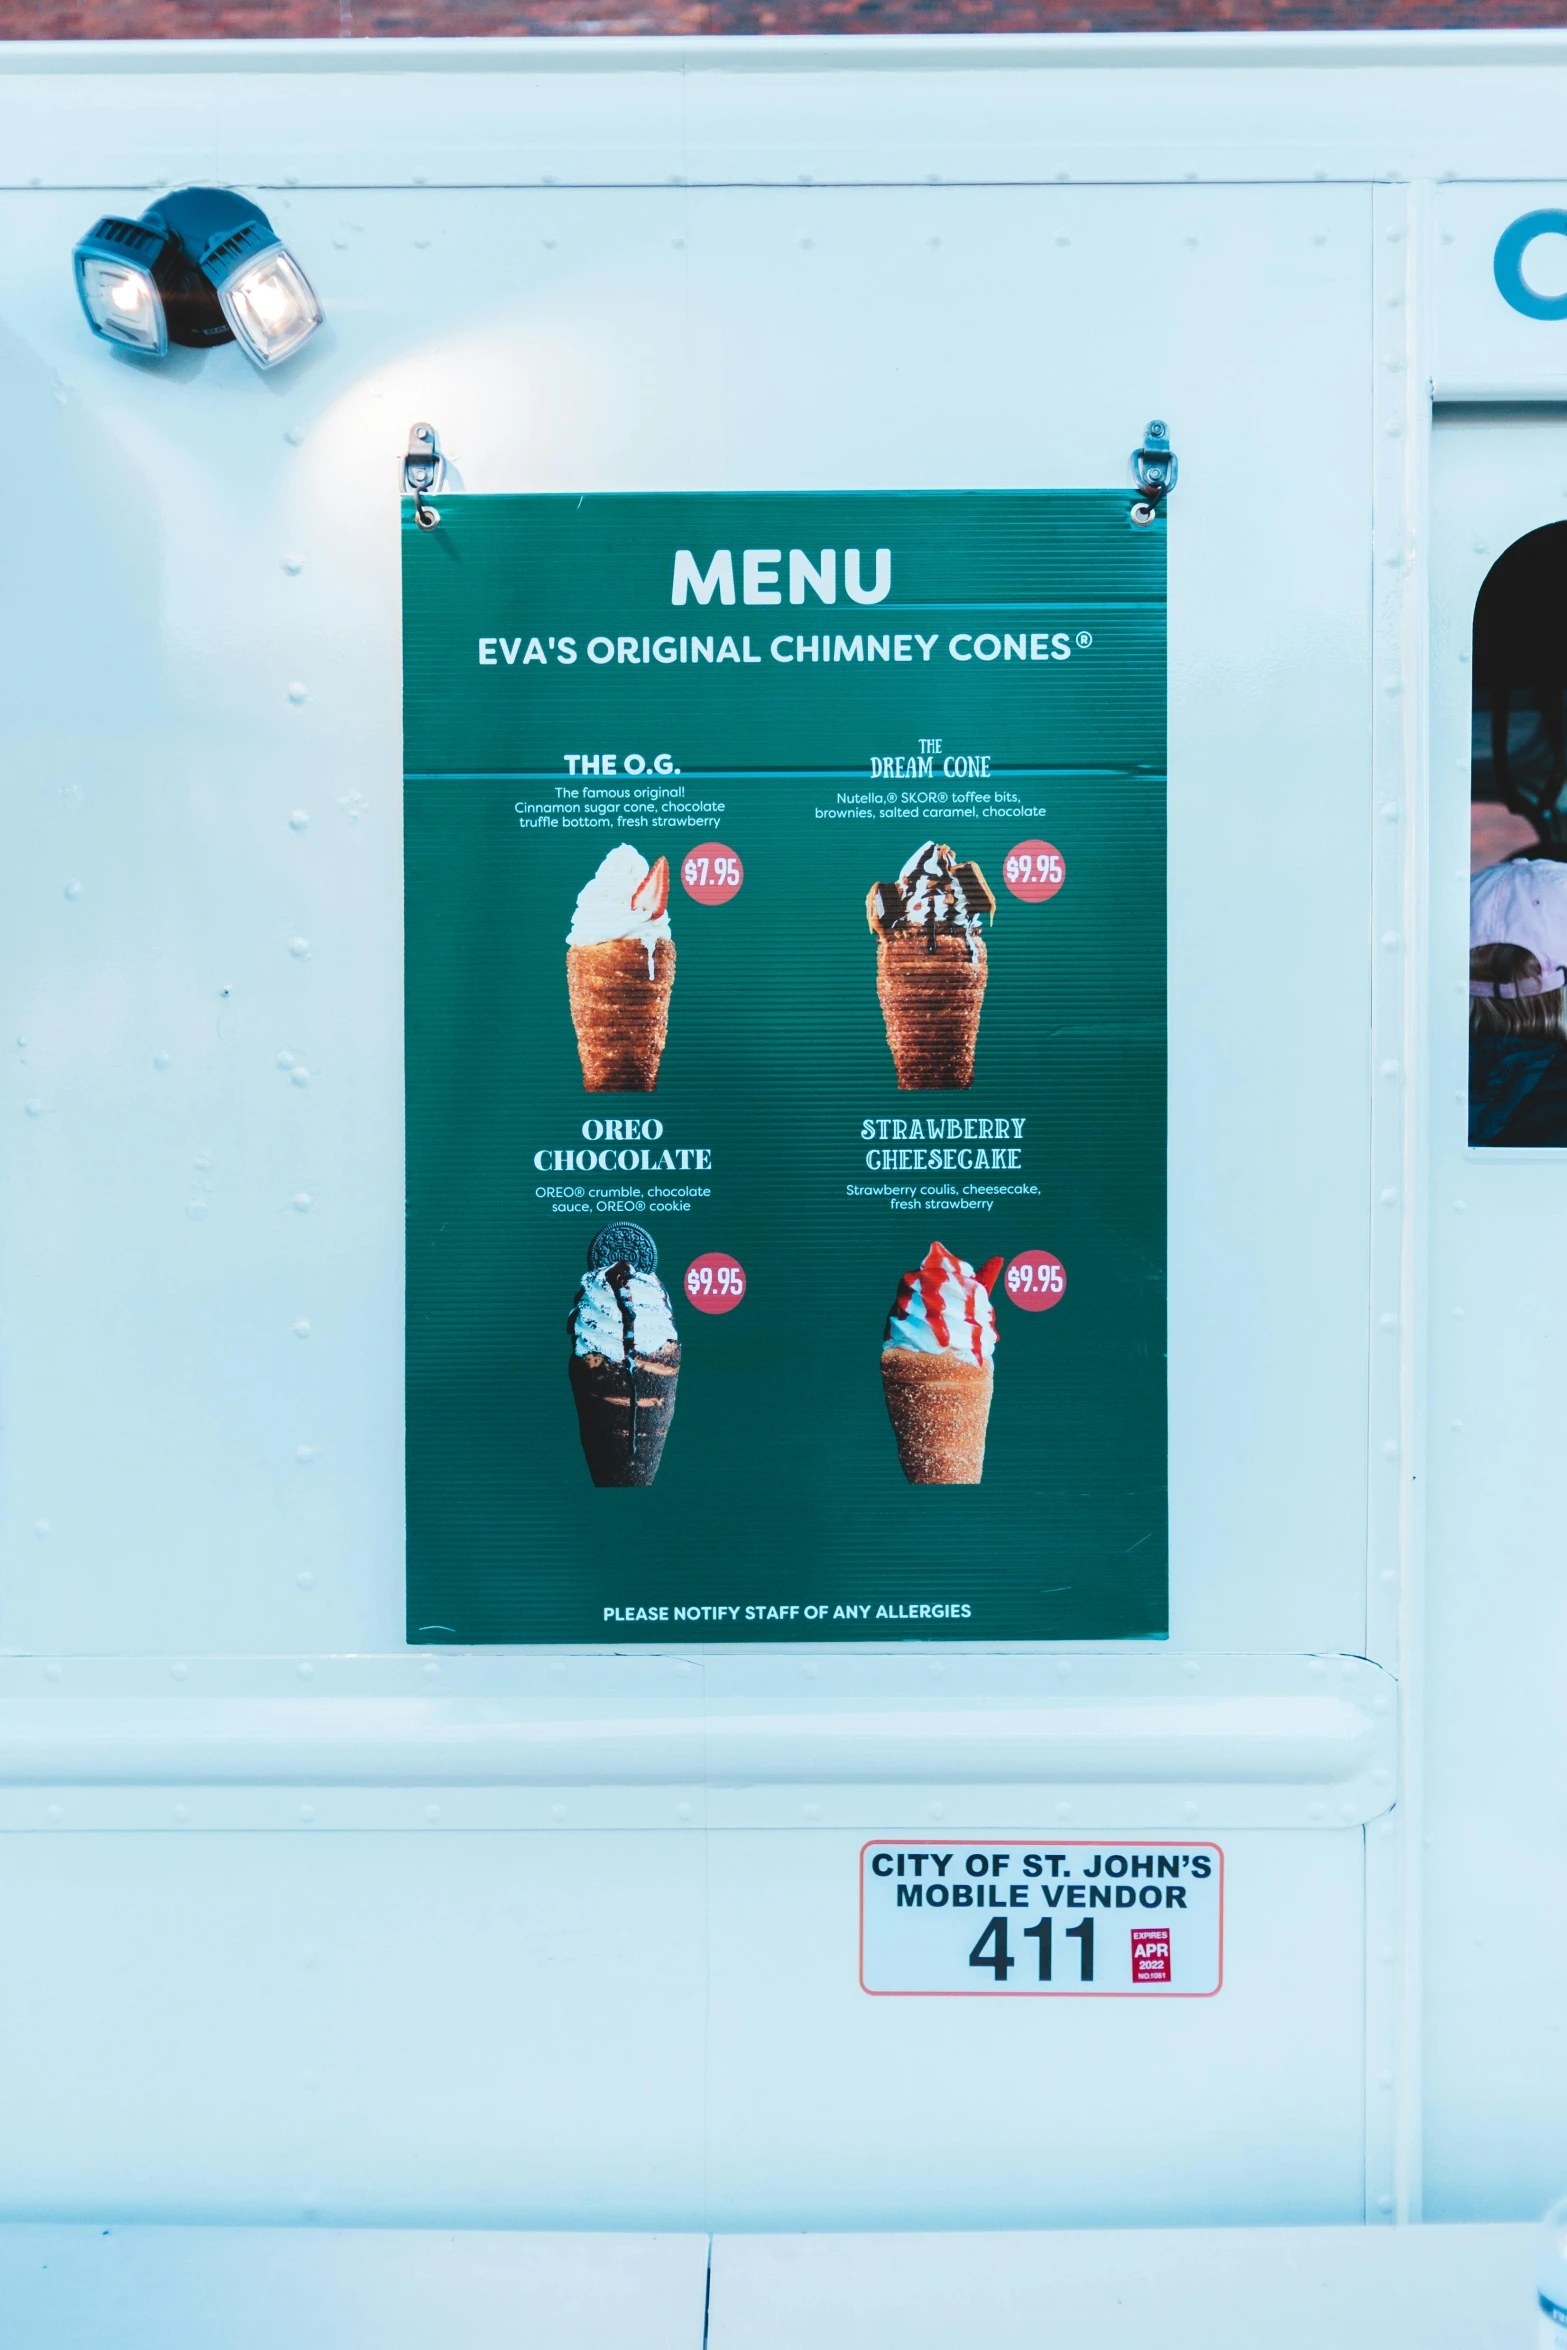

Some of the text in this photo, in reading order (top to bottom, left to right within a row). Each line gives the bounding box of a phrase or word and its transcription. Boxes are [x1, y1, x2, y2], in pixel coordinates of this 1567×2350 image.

[671, 548, 892, 606] MENU
[478, 637, 577, 665] EVA'S
[587, 636, 761, 665] ORIGINAL
[771, 634, 938, 663] CHIMNEY
[918, 738, 943, 754] THE
[563, 753, 681, 776] THE O.G.
[870, 755, 991, 779] DREAM CONE
[555, 786, 685, 800] The famous original!
[900, 791, 949, 804] SKOR®
[951, 790, 991, 803] toffee
[994, 790, 1021, 804] bits,
[514, 801, 726, 816] Cinnamon sugar cone, chocolate
[815, 805, 1047, 819] brownies, salted caramel, chocolate
[519, 815, 721, 829] truffle bottom, fresh strawberry
[684, 856, 740, 887] $7.95
[1006, 854, 1063, 884] $9.95
[581, 1118, 664, 1141] OREO
[860, 1117, 1026, 1141] STRAWBERRY
[533, 1148, 712, 1172] CHOCOLATE
[865, 1148, 1022, 1171] CHEESECAKE
[535, 1186, 711, 1199] OREO® crumble, chocolate
[846, 1183, 1042, 1198] Strawberry coulis, cheesecake,
[552, 1200, 691, 1213] sauce, OREO® cookie
[890, 1198, 994, 1211] fresh strawberry
[687, 1267, 743, 1296] $9.95
[1007, 1264, 1064, 1293] $9.95
[603, 1603, 972, 1622] PLEASE NOTIFY STAFF OF ANY ALLERGIES
[872, 1853, 1212, 1879] CITY OF ST. JOHN’S
[896, 1883, 1188, 1909] MOBILE VENDOR
[1133, 1931, 1168, 1940] EXPIRES
[968, 1915, 1095, 1983] 411
[1134, 1943, 1169, 1958] APR
[1139, 1960, 1165, 1970] 2022
